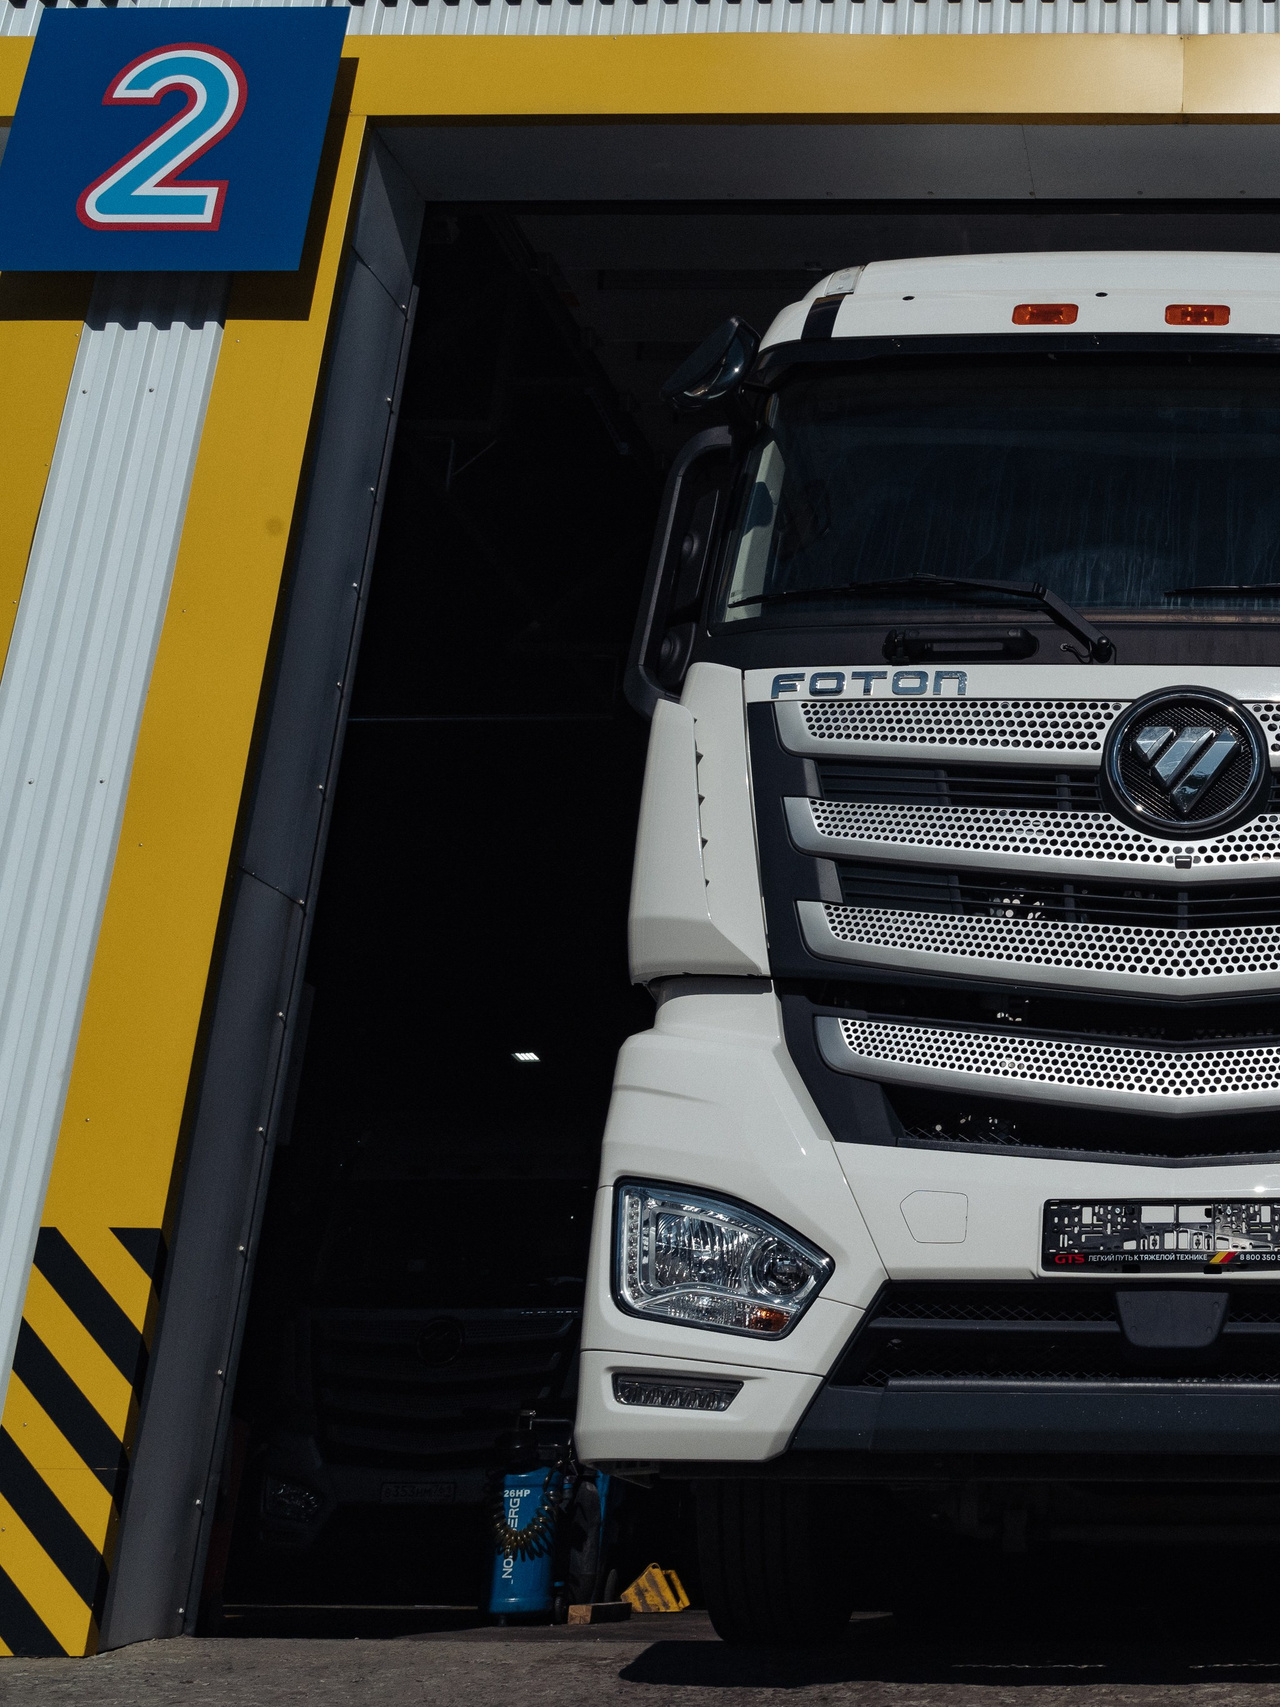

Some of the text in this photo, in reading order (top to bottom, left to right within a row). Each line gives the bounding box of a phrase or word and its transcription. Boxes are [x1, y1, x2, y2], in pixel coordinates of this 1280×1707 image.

[76, 42, 248, 231] 2
[771, 670, 967, 699] FOTON
[1054, 1254, 1085, 1264] GTS
[1088, 1253, 1114, 1262] ЛЕГКИЙ
[1140, 1252, 1175, 1261] ТЯЖЕЛОЙ
[1176, 1253, 1208, 1261] ТЕХНИКЕ
[503, 1489, 531, 1498] 26HP
